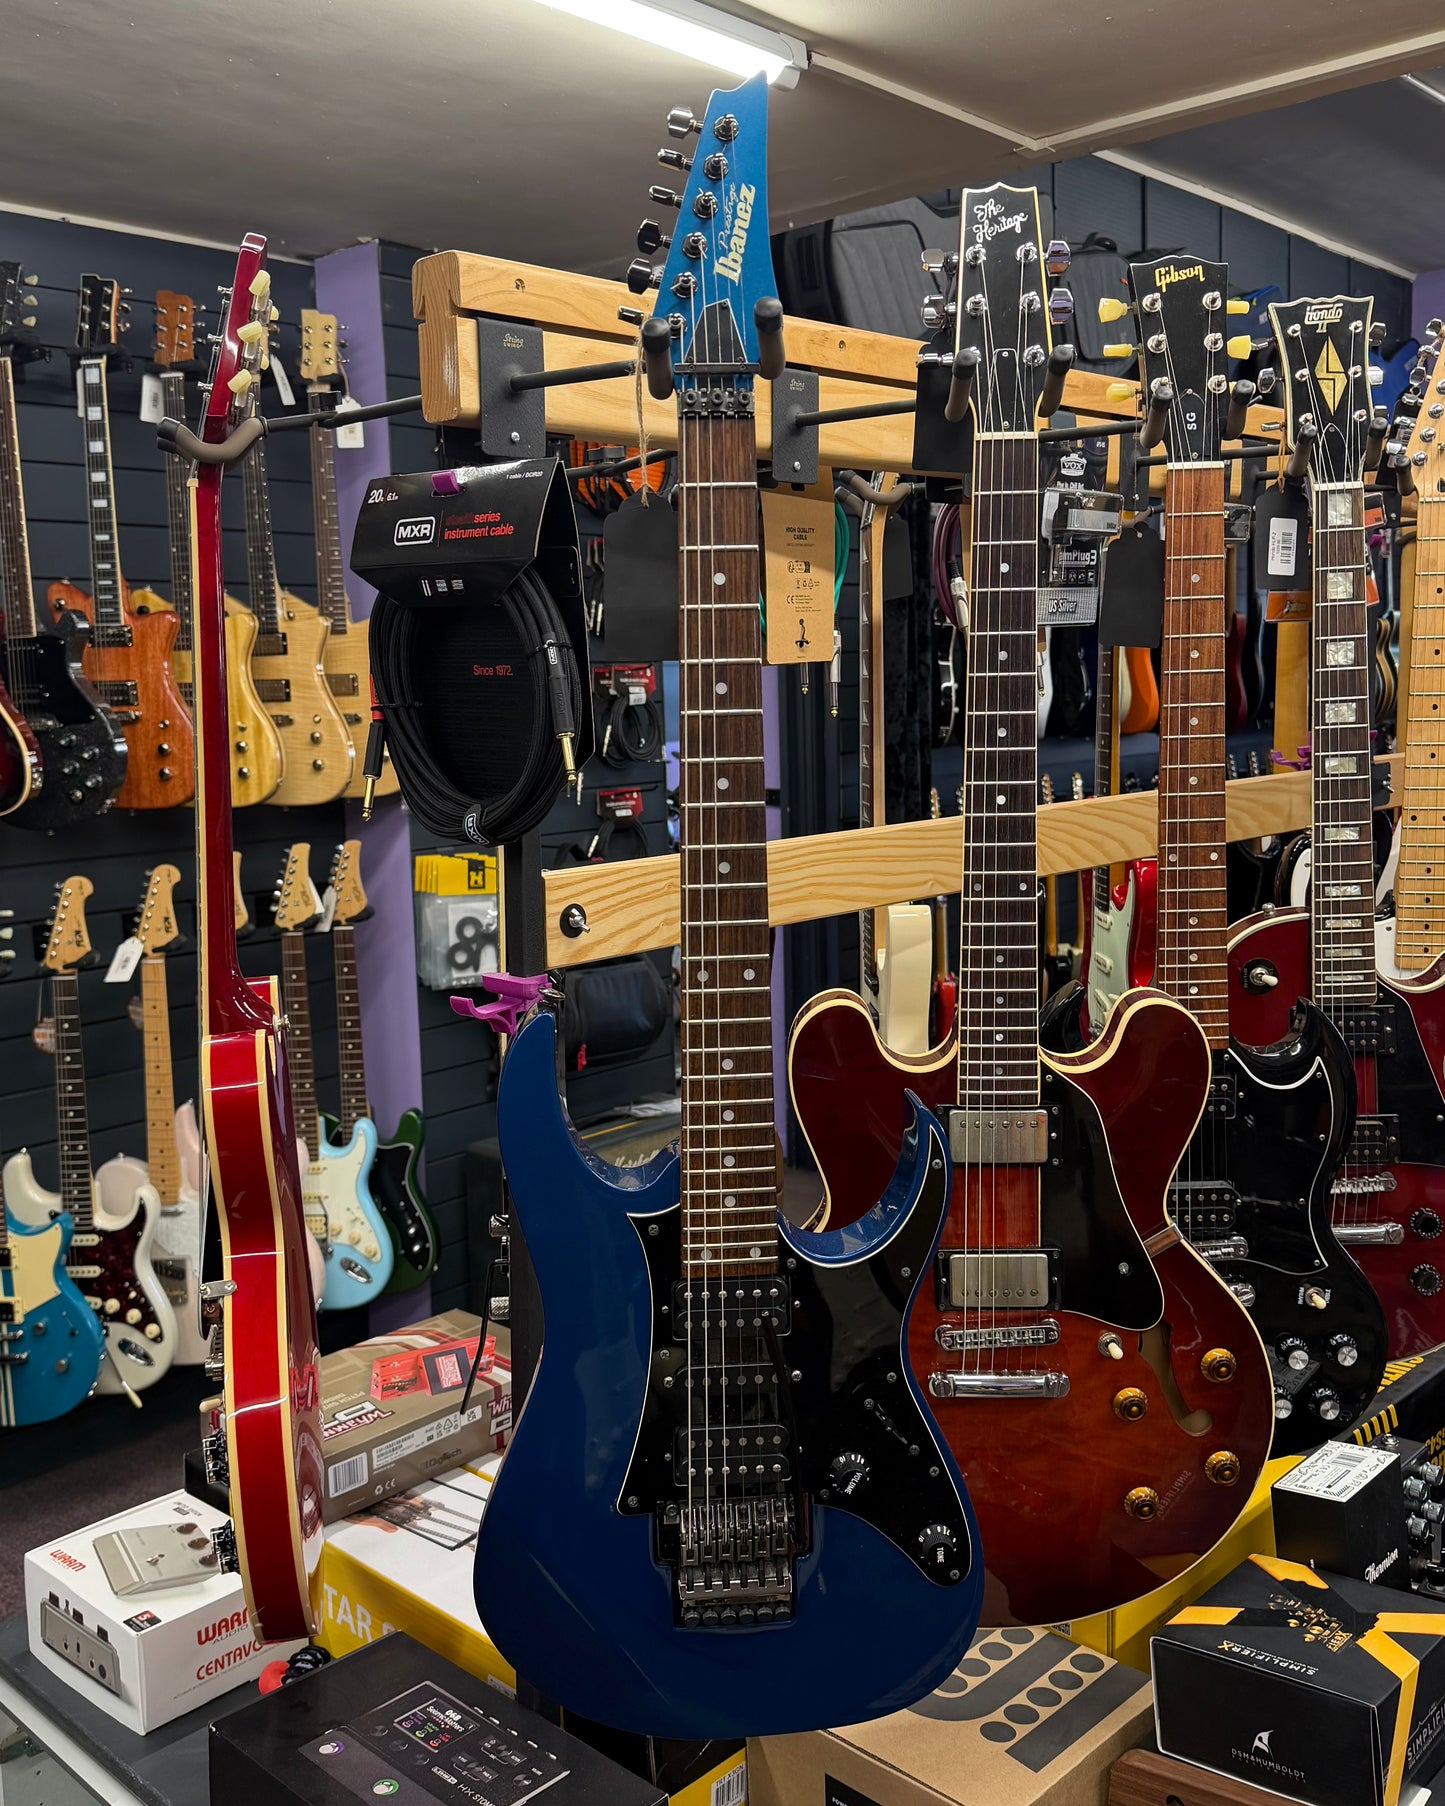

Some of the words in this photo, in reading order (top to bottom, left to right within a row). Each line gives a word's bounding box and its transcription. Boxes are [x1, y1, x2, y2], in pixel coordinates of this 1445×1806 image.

[718, 182, 738, 250] Prestige
[973, 198, 1005, 222] The
[713, 183, 756, 286] Ibanez
[972, 212, 1029, 243] Heritage
[1154, 264, 1206, 293] Gibson
[1186, 412, 1197, 430] SG
[1064, 461, 1083, 470] VOX
[473, 510, 502, 524] series
[398, 523, 431, 540] MXR
[443, 526, 489, 540] instrument
[489, 523, 515, 536] cable
[473, 665, 494, 675] Since
[844, 1472, 863, 1495] VOLUME
[49, 1549, 87, 1573] WARM
[936, 1546, 945, 1564] TONE
[1364, 1548, 1399, 1584] Thermion
[457, 1783, 475, 1797] HX
